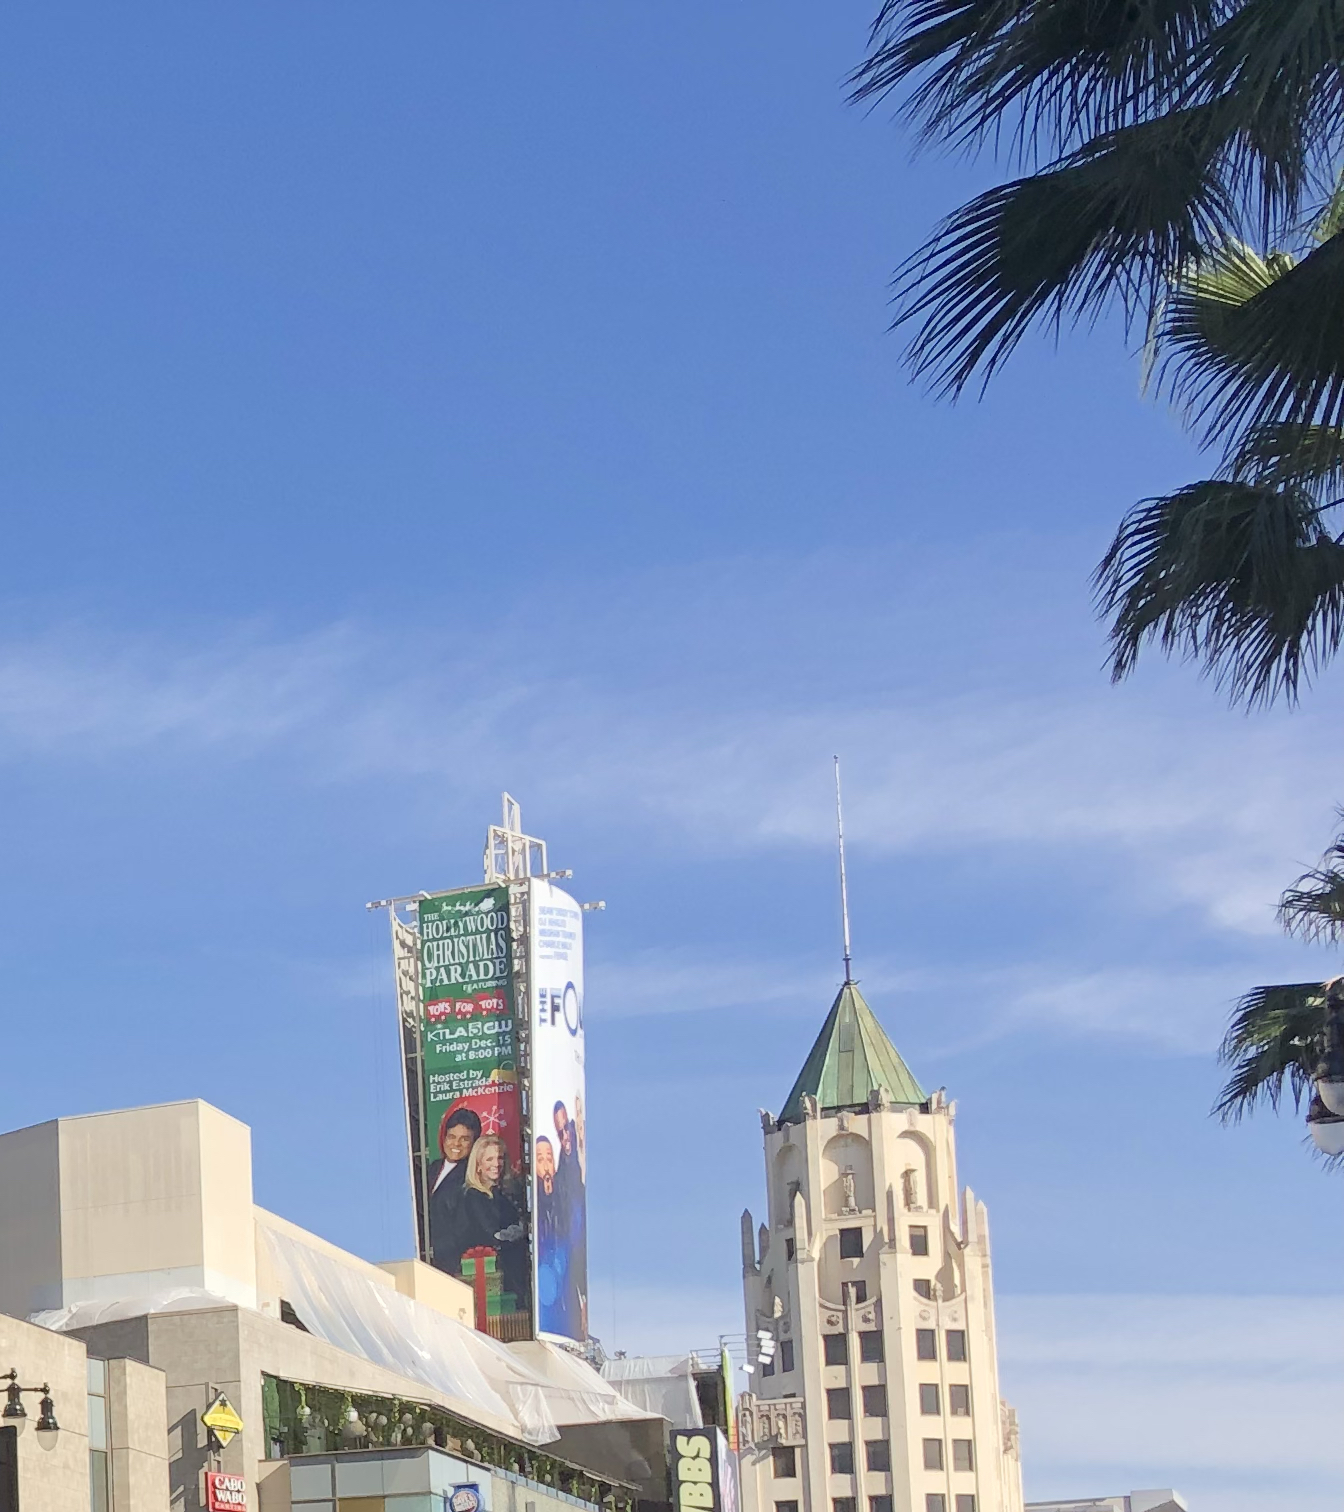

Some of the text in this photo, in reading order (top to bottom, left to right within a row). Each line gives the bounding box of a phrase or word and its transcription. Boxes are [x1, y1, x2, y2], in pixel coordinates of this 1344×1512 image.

[424, 913, 439, 921] THE
[423, 911, 508, 940] HOLLYWOOD
[424, 930, 507, 968] CHRISTMAS
[425, 958, 508, 988] PARADE
[463, 979, 507, 993] FEATURING
[428, 999, 504, 1015] TOYS FOR TOTS
[427, 1026, 467, 1042] KTLA
[436, 1035, 511, 1053] Friday Dec. 15
[455, 1045, 512, 1061] at 8:00 PM
[430, 1069, 483, 1083] Hosted by
[430, 1076, 492, 1092] Erik Estrada
[430, 1084, 514, 1102] Laura McKenzie
[215, 1475, 246, 1491] CABO
[215, 1489, 246, 1505] WABO
